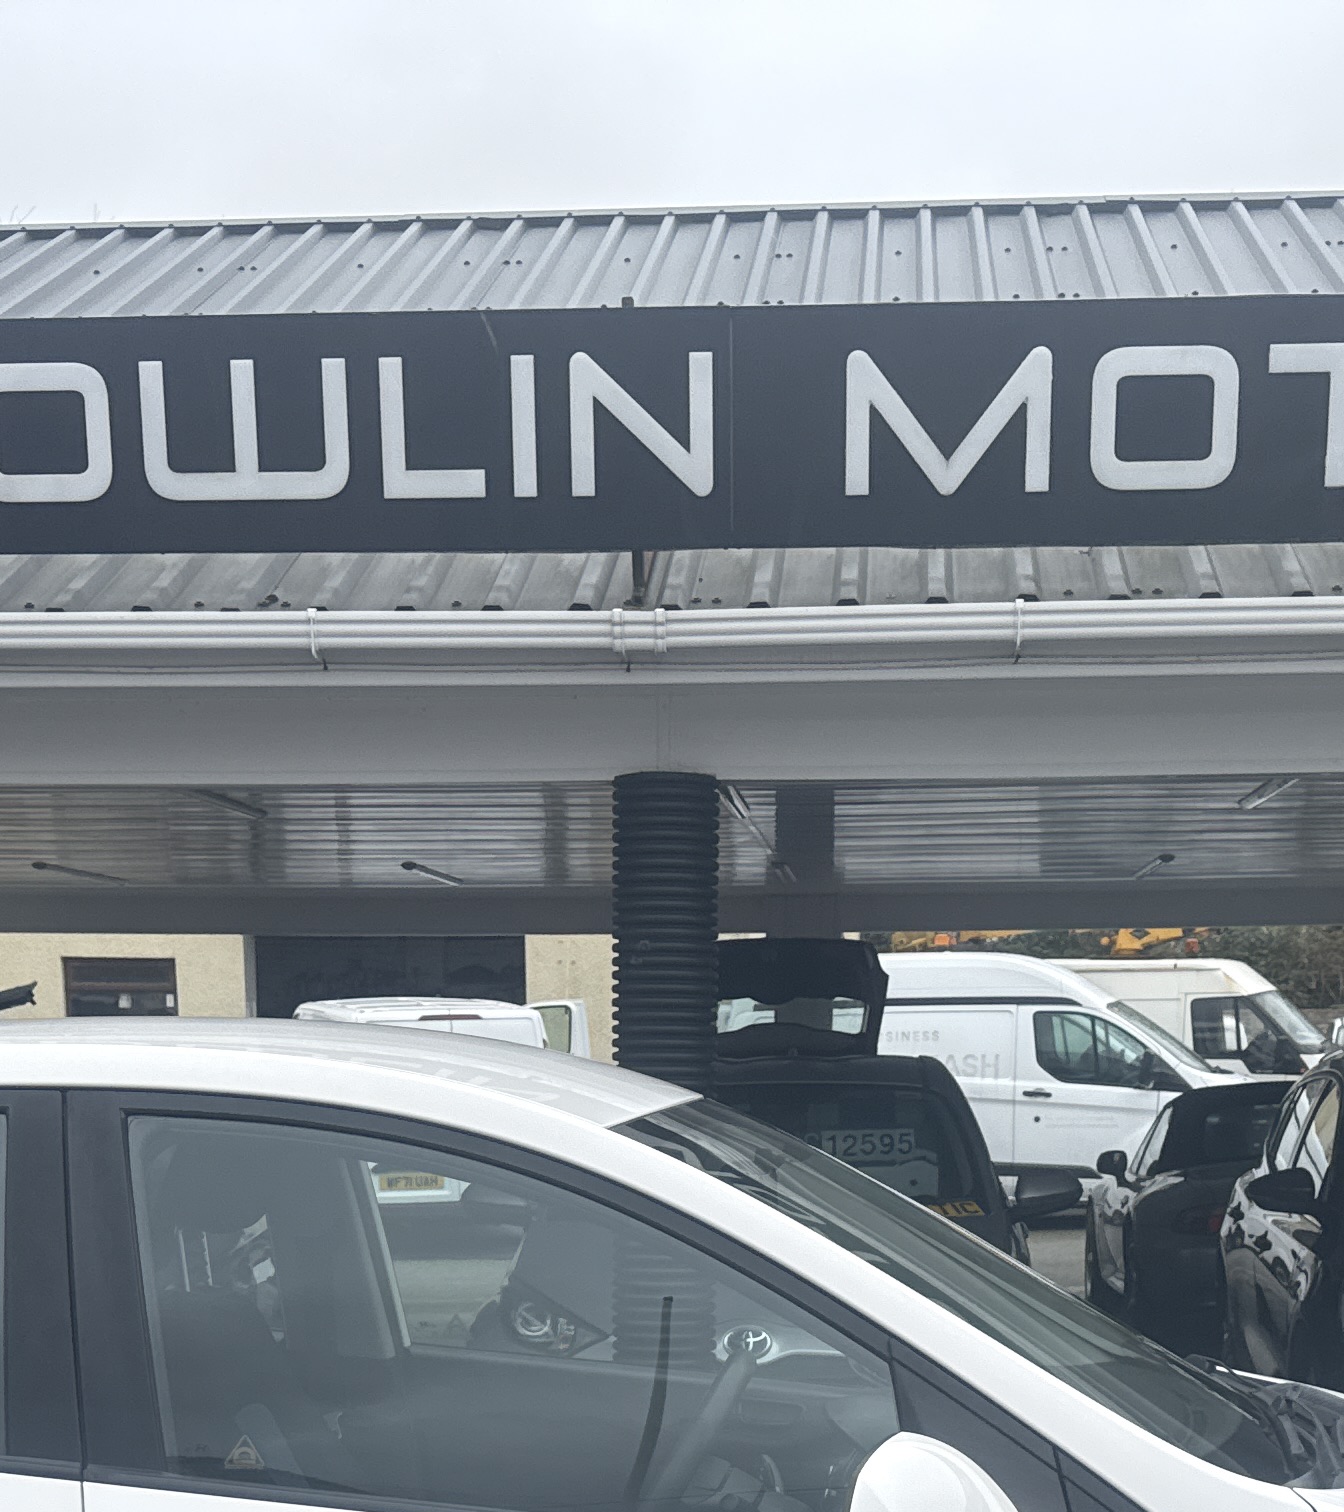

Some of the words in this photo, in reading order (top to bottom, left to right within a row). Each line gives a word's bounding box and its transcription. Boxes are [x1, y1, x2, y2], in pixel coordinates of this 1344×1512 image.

[882, 1030, 940, 1042] SINESS
[943, 1053, 1001, 1079] ASH
[825, 1132, 914, 1157] 12595
